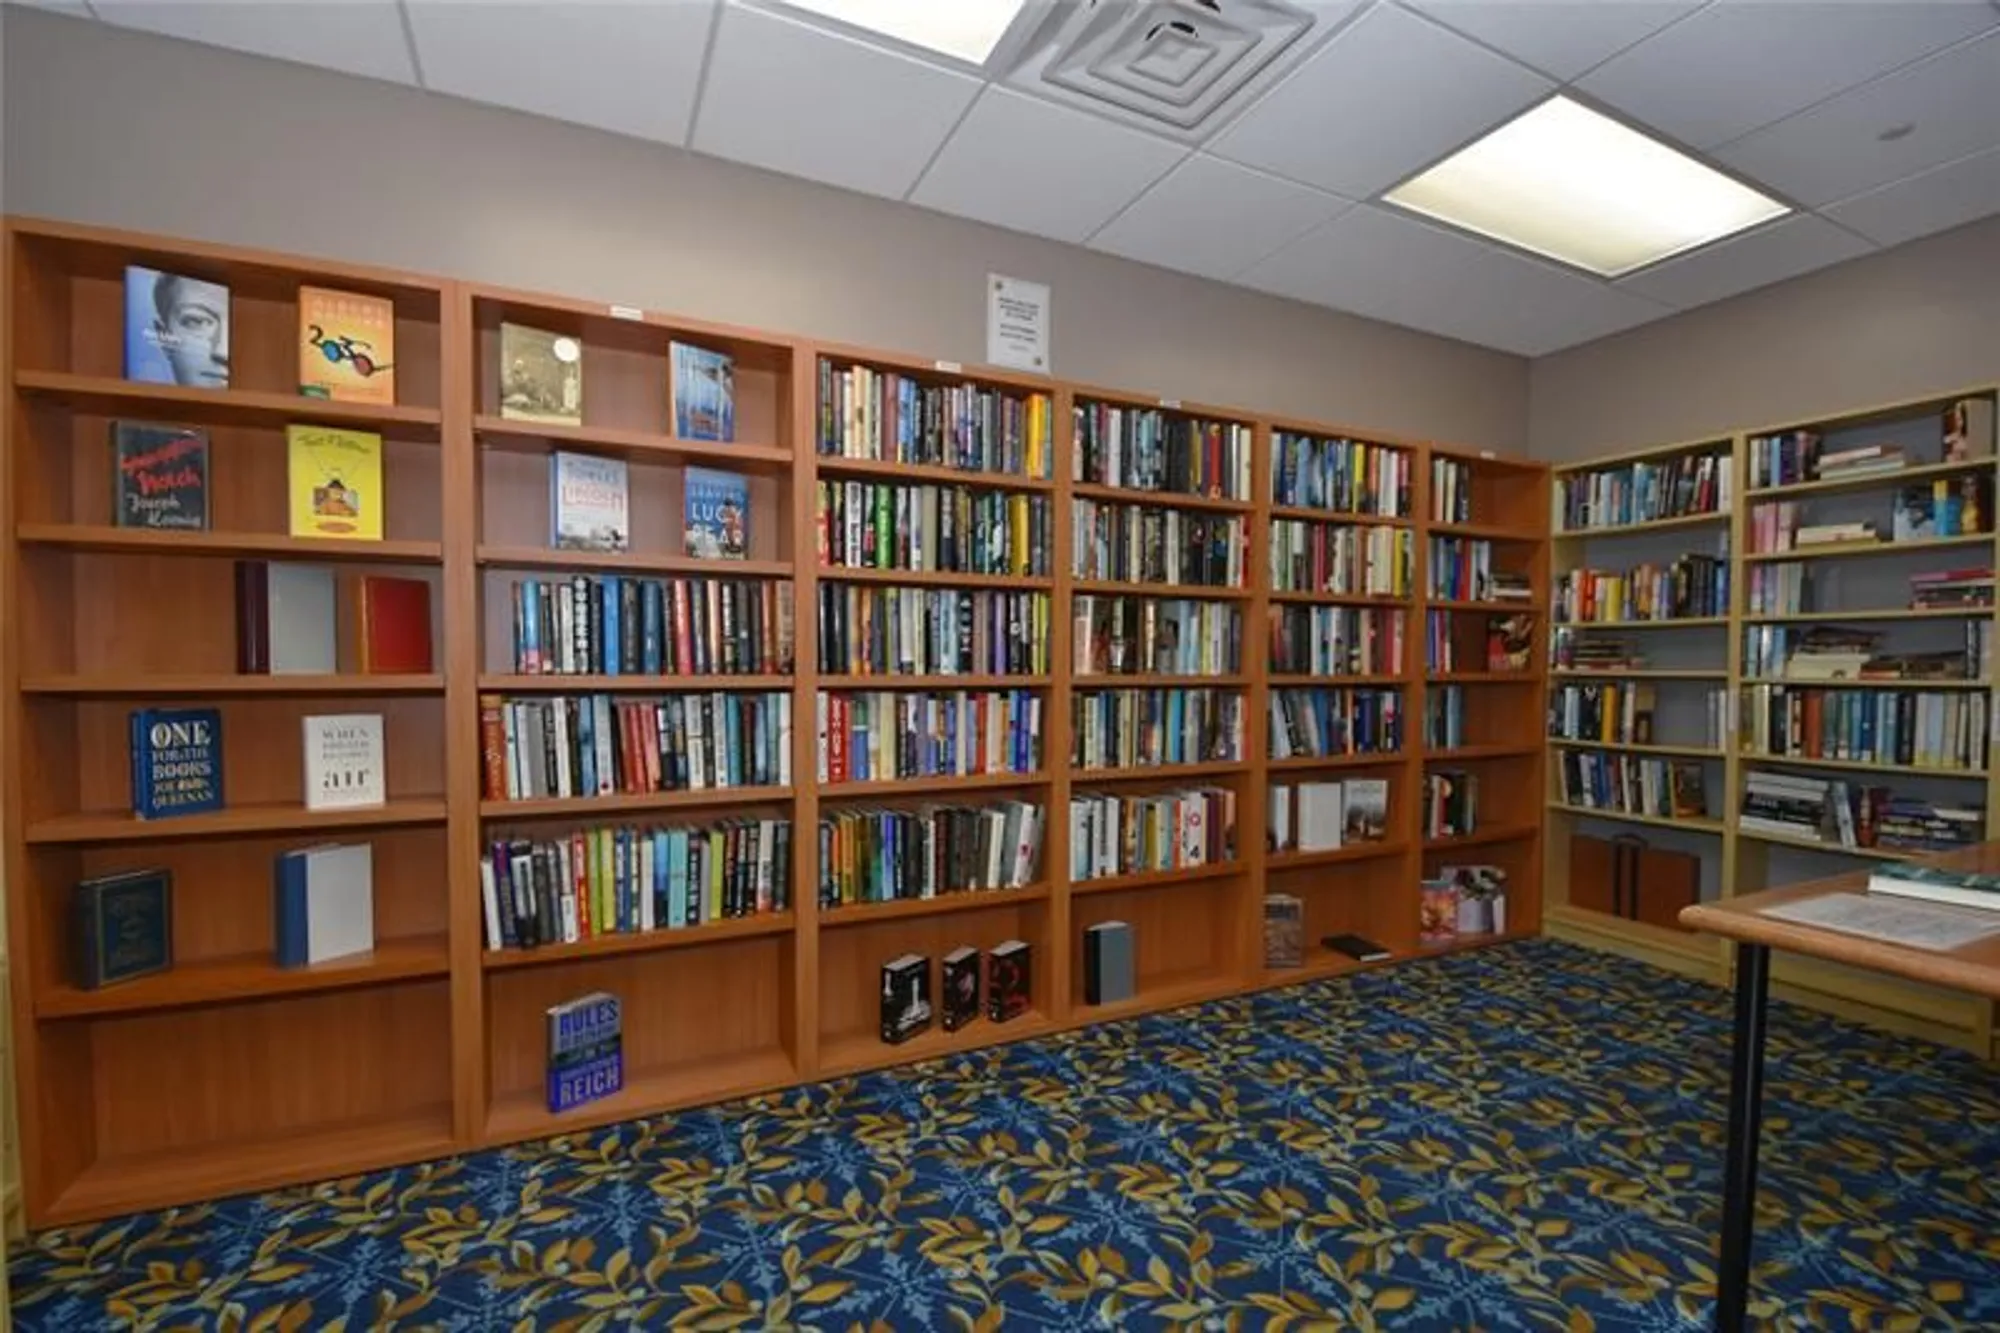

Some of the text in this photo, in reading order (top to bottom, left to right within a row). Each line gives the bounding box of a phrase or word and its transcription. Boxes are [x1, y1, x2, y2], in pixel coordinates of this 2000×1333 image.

[692, 502, 744, 524] LUCY
[150, 719, 212, 749] ONE
[152, 760, 212, 780] BOOKS
[323, 767, 371, 788] air
[560, 1065, 620, 1107] REICH
